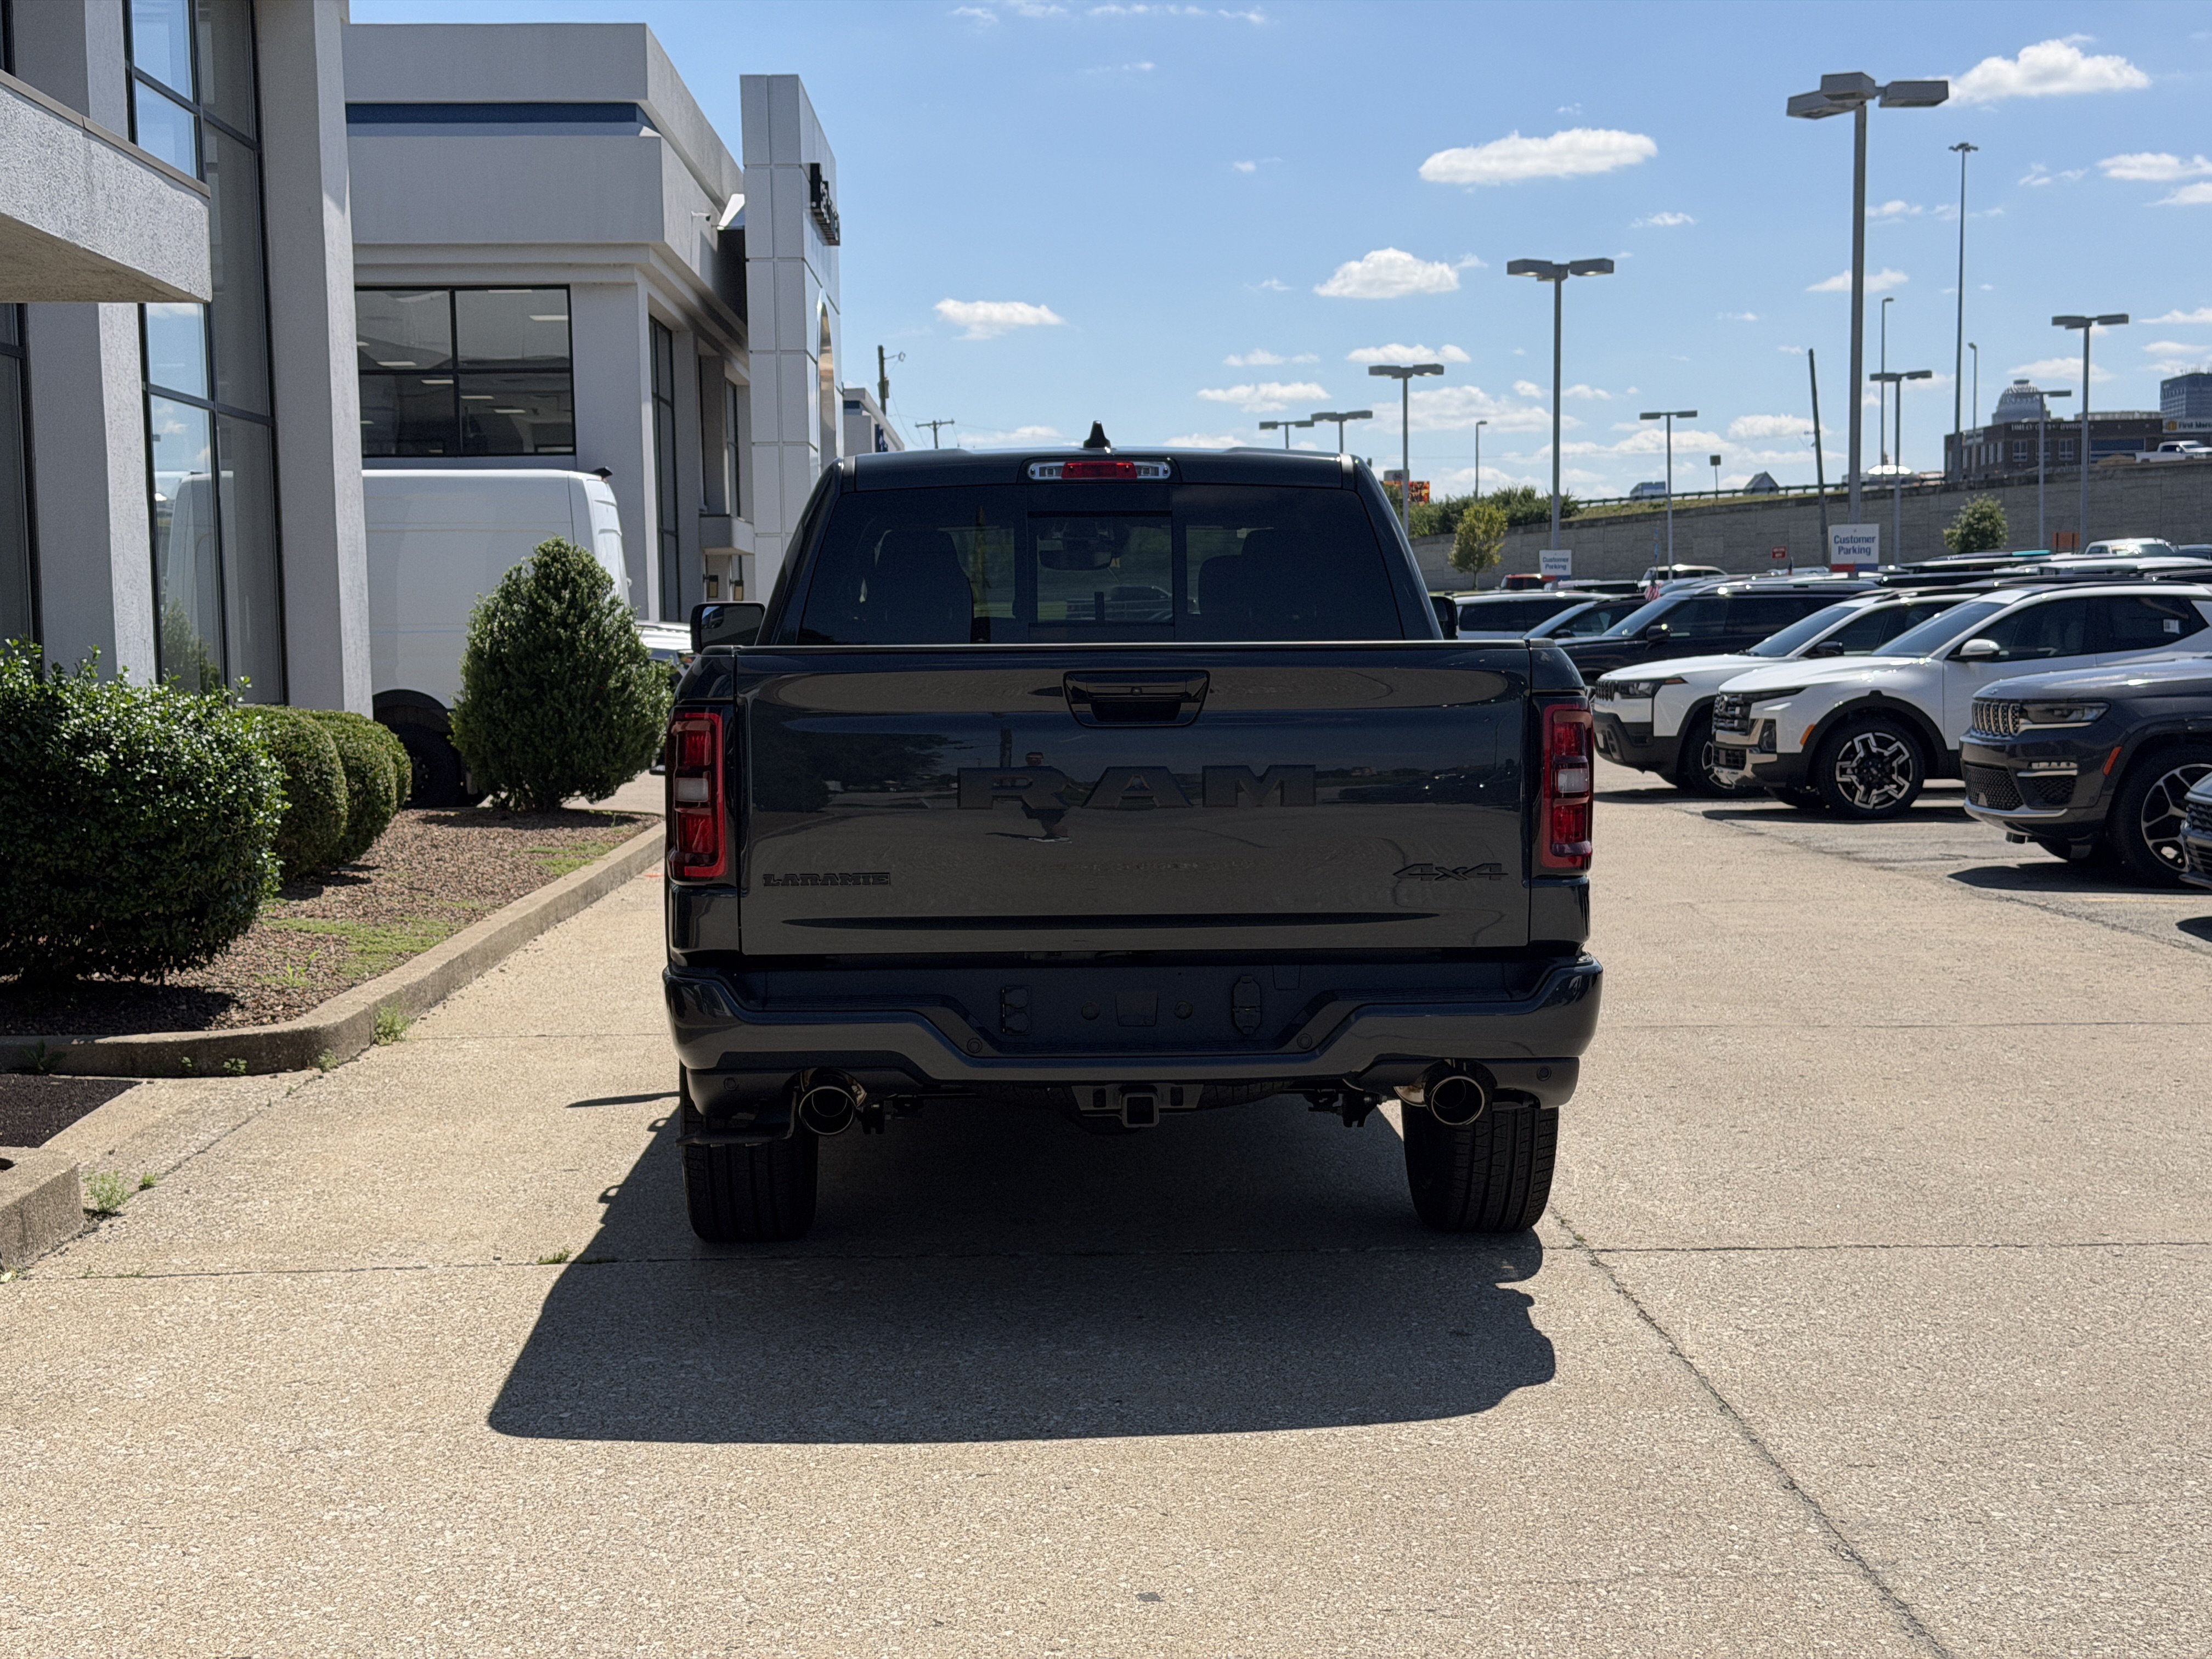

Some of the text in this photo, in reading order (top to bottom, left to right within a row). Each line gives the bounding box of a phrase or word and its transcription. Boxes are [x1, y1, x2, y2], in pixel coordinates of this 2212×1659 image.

[1833, 535, 1876, 544] Customer
[1838, 546, 1871, 556] Parking
[957, 765, 1316, 810] RAM
[763, 872, 891, 887] LARAMIE
